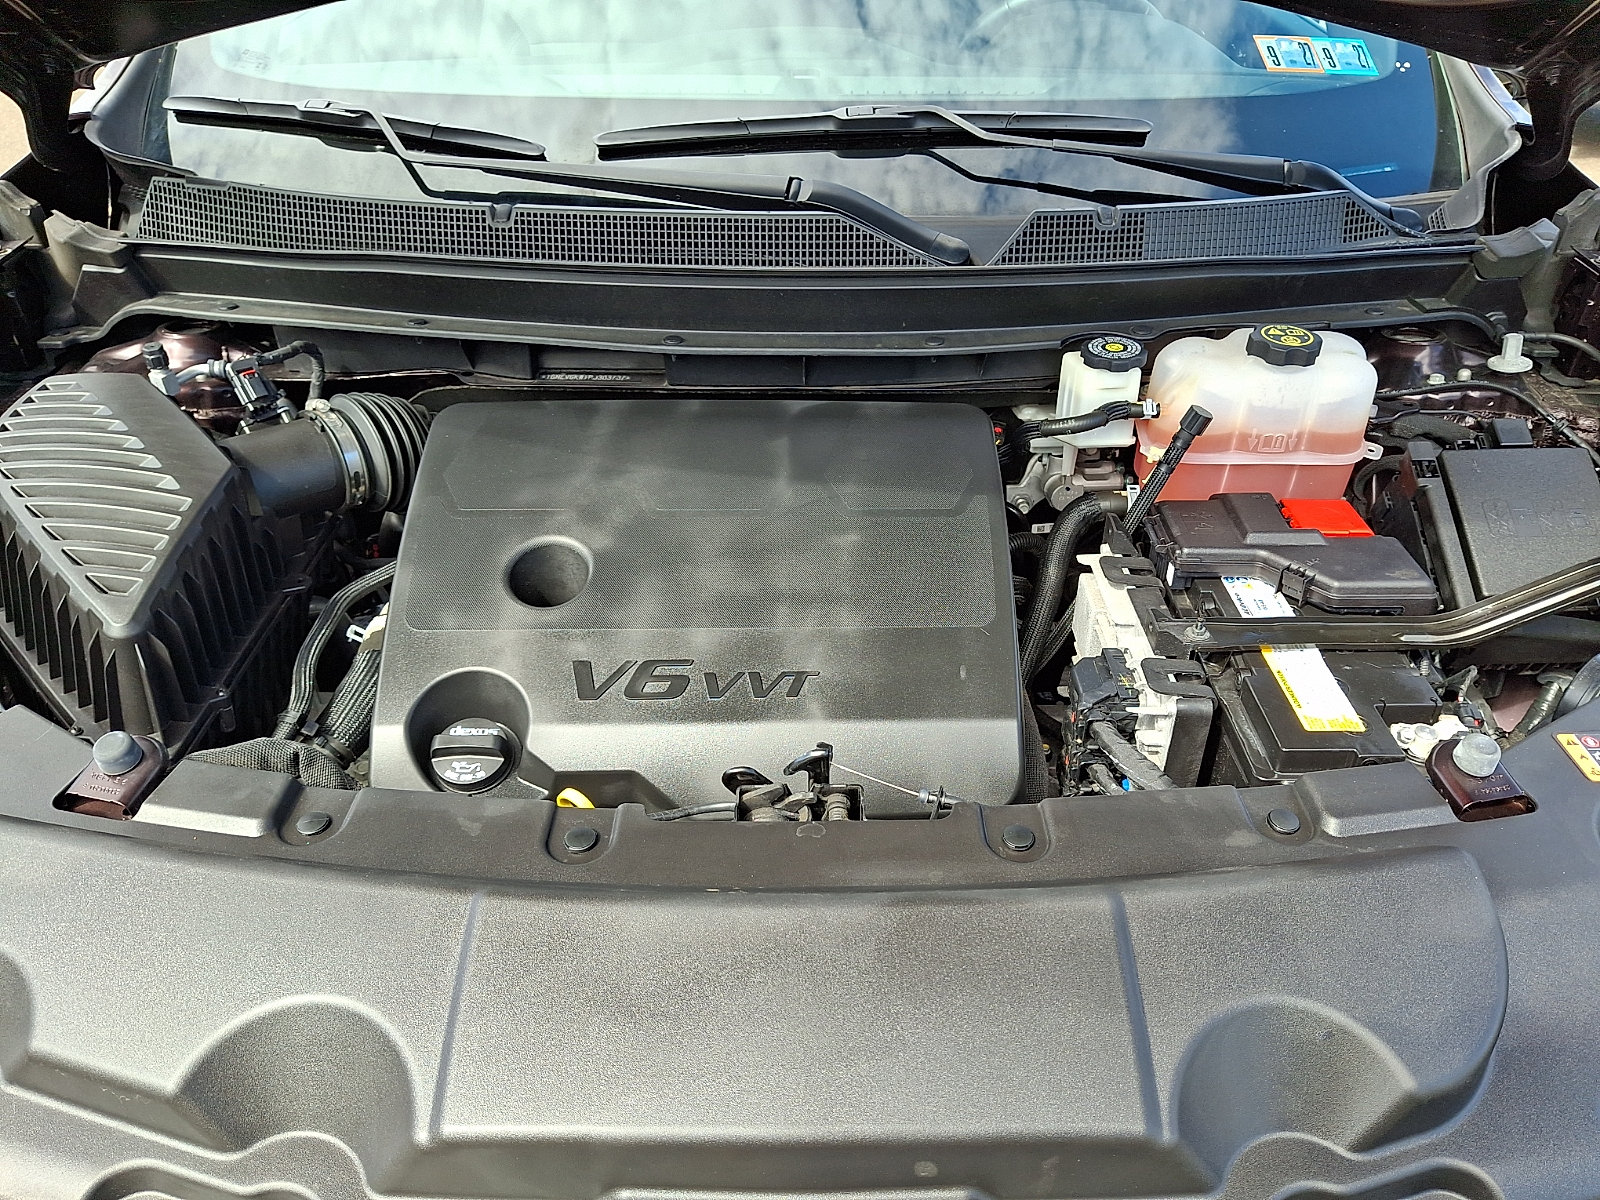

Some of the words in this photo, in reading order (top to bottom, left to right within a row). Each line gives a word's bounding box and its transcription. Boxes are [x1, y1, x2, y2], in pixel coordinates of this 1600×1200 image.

[1266, 45, 1281, 67] 9
[1297, 42, 1317, 68] 27
[1322, 47, 1337, 68] 9
[1352, 44, 1371, 69] 27
[572, 659, 695, 701] V6
[703, 671, 821, 700] VVT
[449, 725, 501, 736] dexos
